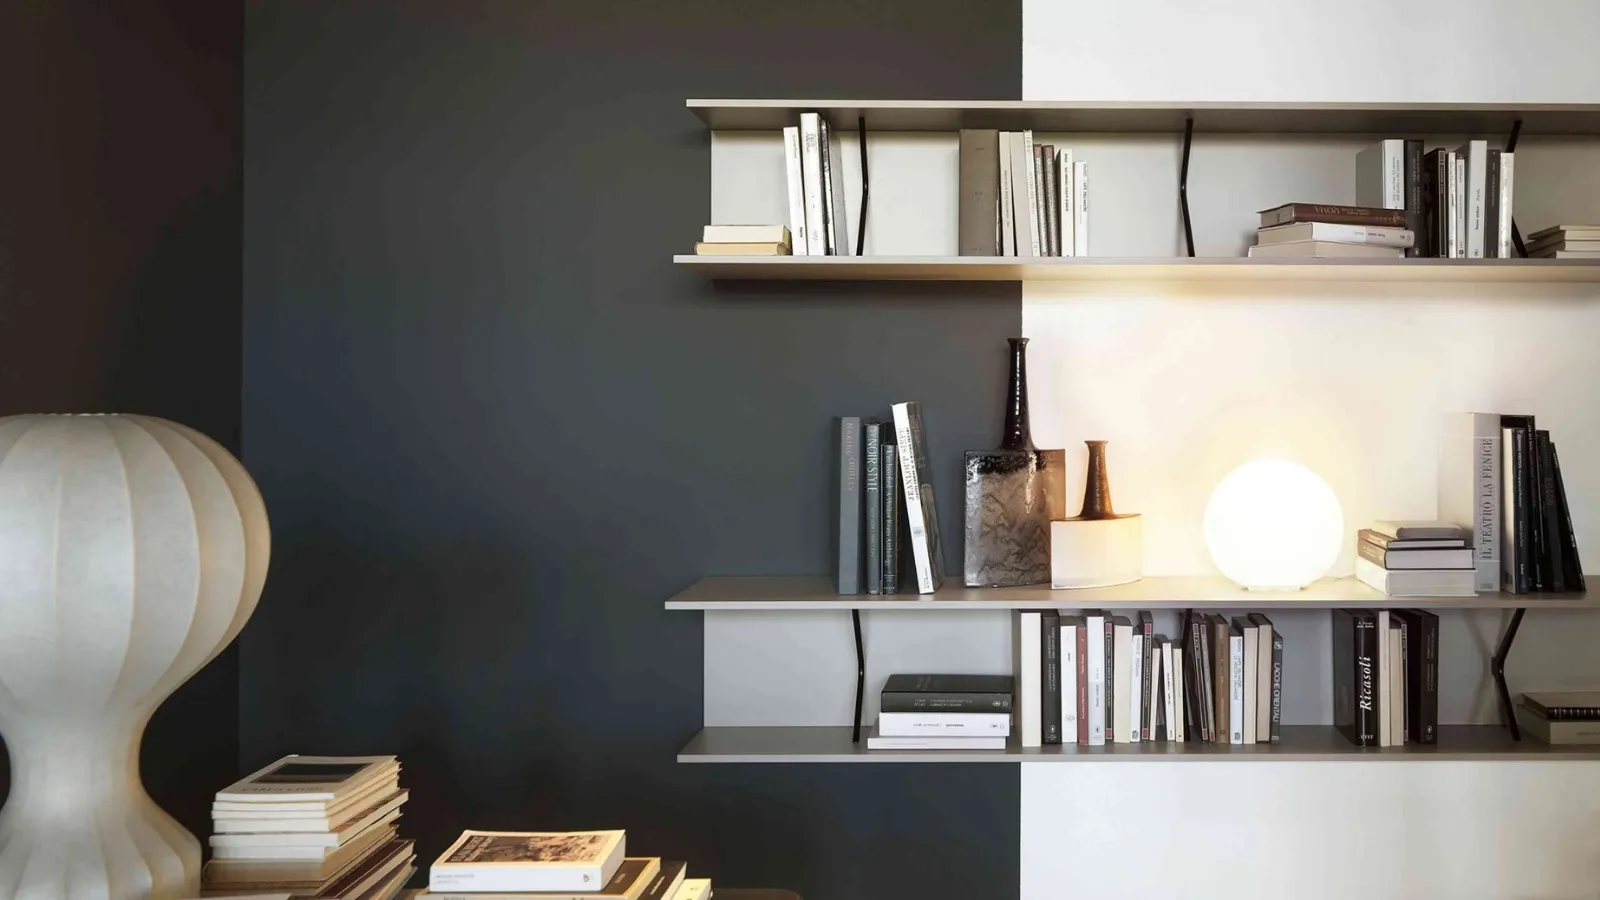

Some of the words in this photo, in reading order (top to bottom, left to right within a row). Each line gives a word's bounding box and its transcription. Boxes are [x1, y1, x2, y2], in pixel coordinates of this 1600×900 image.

[845, 423, 853, 455] MAKING
[867, 438, 878, 464] NOIR
[848, 457, 856, 491] CHOICES
[885, 450, 893, 488] Unclassified
[1482, 439, 1493, 479] FENICE
[867, 467, 879, 492] STYLE
[1482, 484, 1492, 497] LA
[1482, 502, 1492, 545] TEATRO
[1482, 547, 1492, 559] IL
[1359, 656, 1372, 711] Ricasoli
[1273, 690, 1281, 722] ORIENTALI
